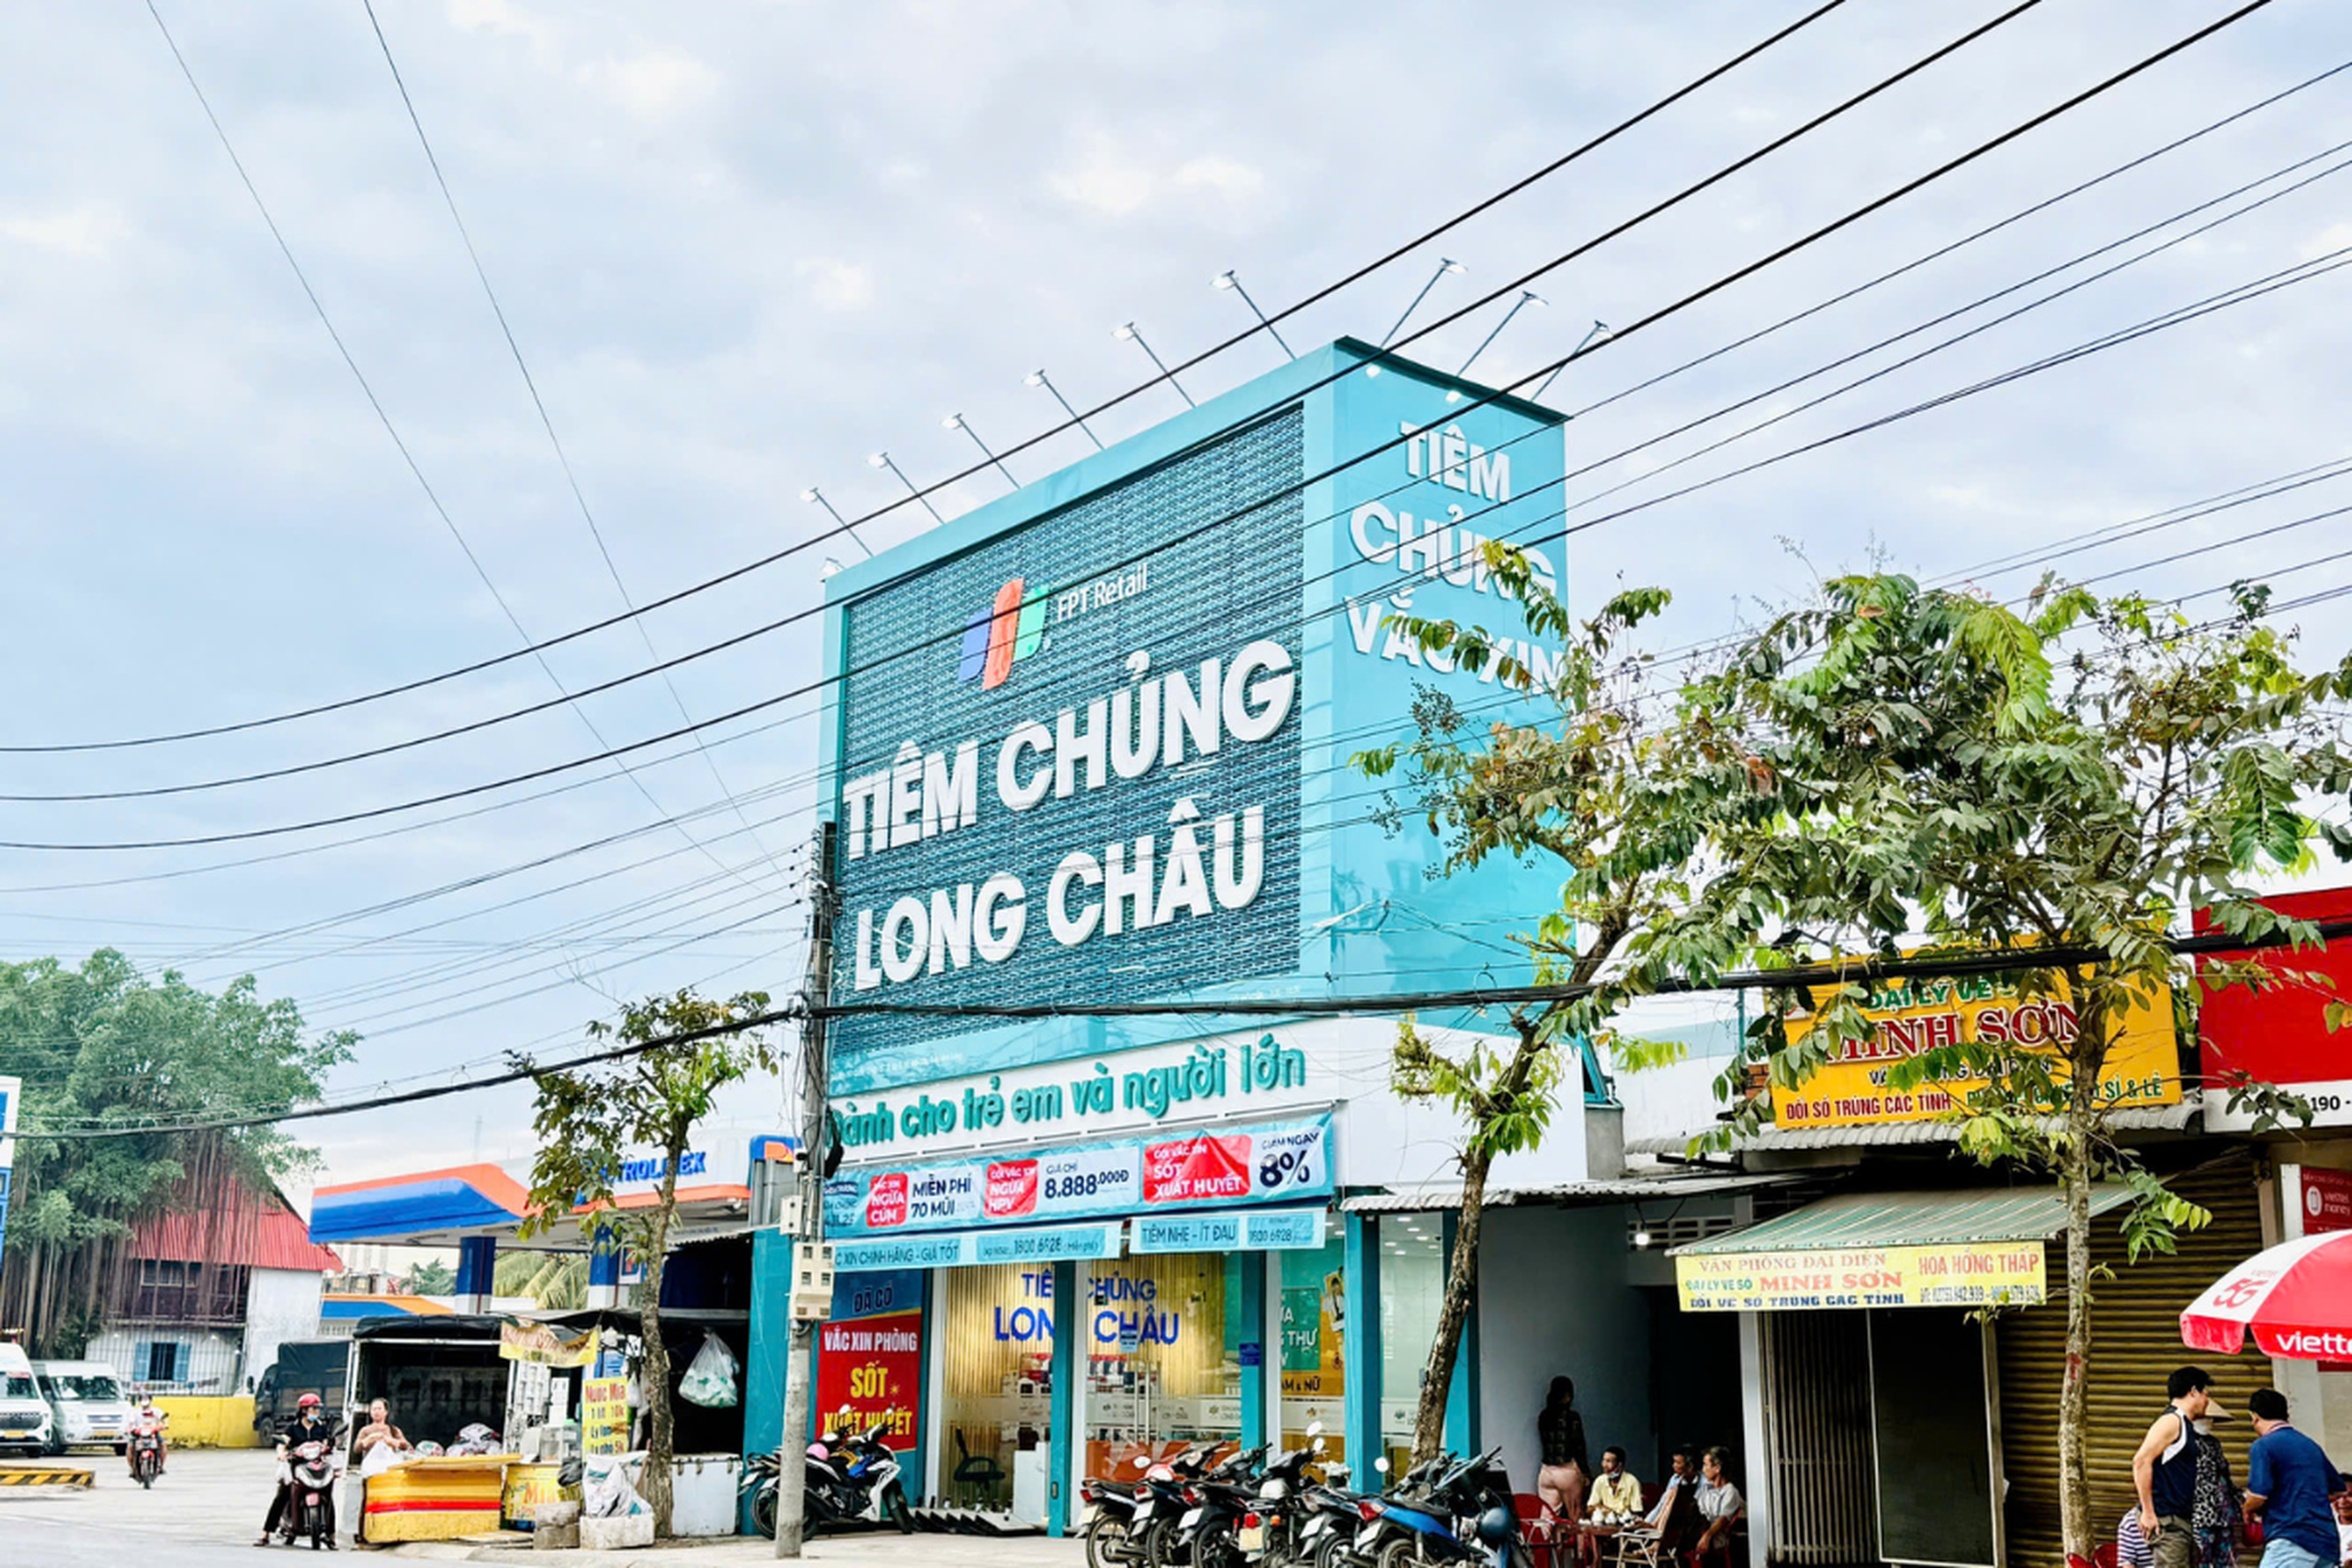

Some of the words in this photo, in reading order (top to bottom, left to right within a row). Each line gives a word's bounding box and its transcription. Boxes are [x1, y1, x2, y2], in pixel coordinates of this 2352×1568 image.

[1400, 422, 1510, 502] TIÊM
[1057, 586, 1091, 623] FPT
[1093, 562, 1148, 609] Retail
[842, 740, 979, 860] TIÊM
[997, 641, 1295, 811] CHỦNG
[854, 872, 1026, 991] LONG
[1047, 795, 1265, 946] CHÂU
[1826, 1014, 1960, 1063] INH
[901, 1095, 956, 1137] cho
[963, 1075, 1004, 1130] trẻ
[1012, 1085, 1062, 1122] em
[1070, 1062, 1114, 1116] và
[1124, 1044, 1227, 1118] người
[1240, 1033, 1306, 1093] lớn
[1286, 1132, 1319, 1145] NGAY
[1154, 1176, 1191, 1199] XUẤT
[1194, 1170, 1242, 1193] HUYẾT
[1260, 1149, 1310, 1188] 8%
[912, 1174, 947, 1198] MIỄN
[949, 1172, 973, 1193] PHÍ
[871, 1206, 898, 1223] CÚM
[911, 1201, 928, 1218] 70
[988, 1198, 1016, 1213] HPV
[1918, 1256, 1948, 1275] HOA
[1997, 1246, 2040, 1273] THẤP
[1022, 1269, 1054, 1298] TIÊ
[1088, 1271, 1157, 1303] HỦNG
[1759, 1274, 1833, 1292] MINH
[1842, 1269, 1903, 1290] SƠN
[2213, 1278, 2268, 1309] 5G
[824, 1325, 851, 1351] VẮC
[851, 1331, 873, 1351] XIN
[875, 1327, 918, 1351] PHÒNG
[995, 1305, 1055, 1342] LON
[851, 1359, 888, 1398] SỐT
